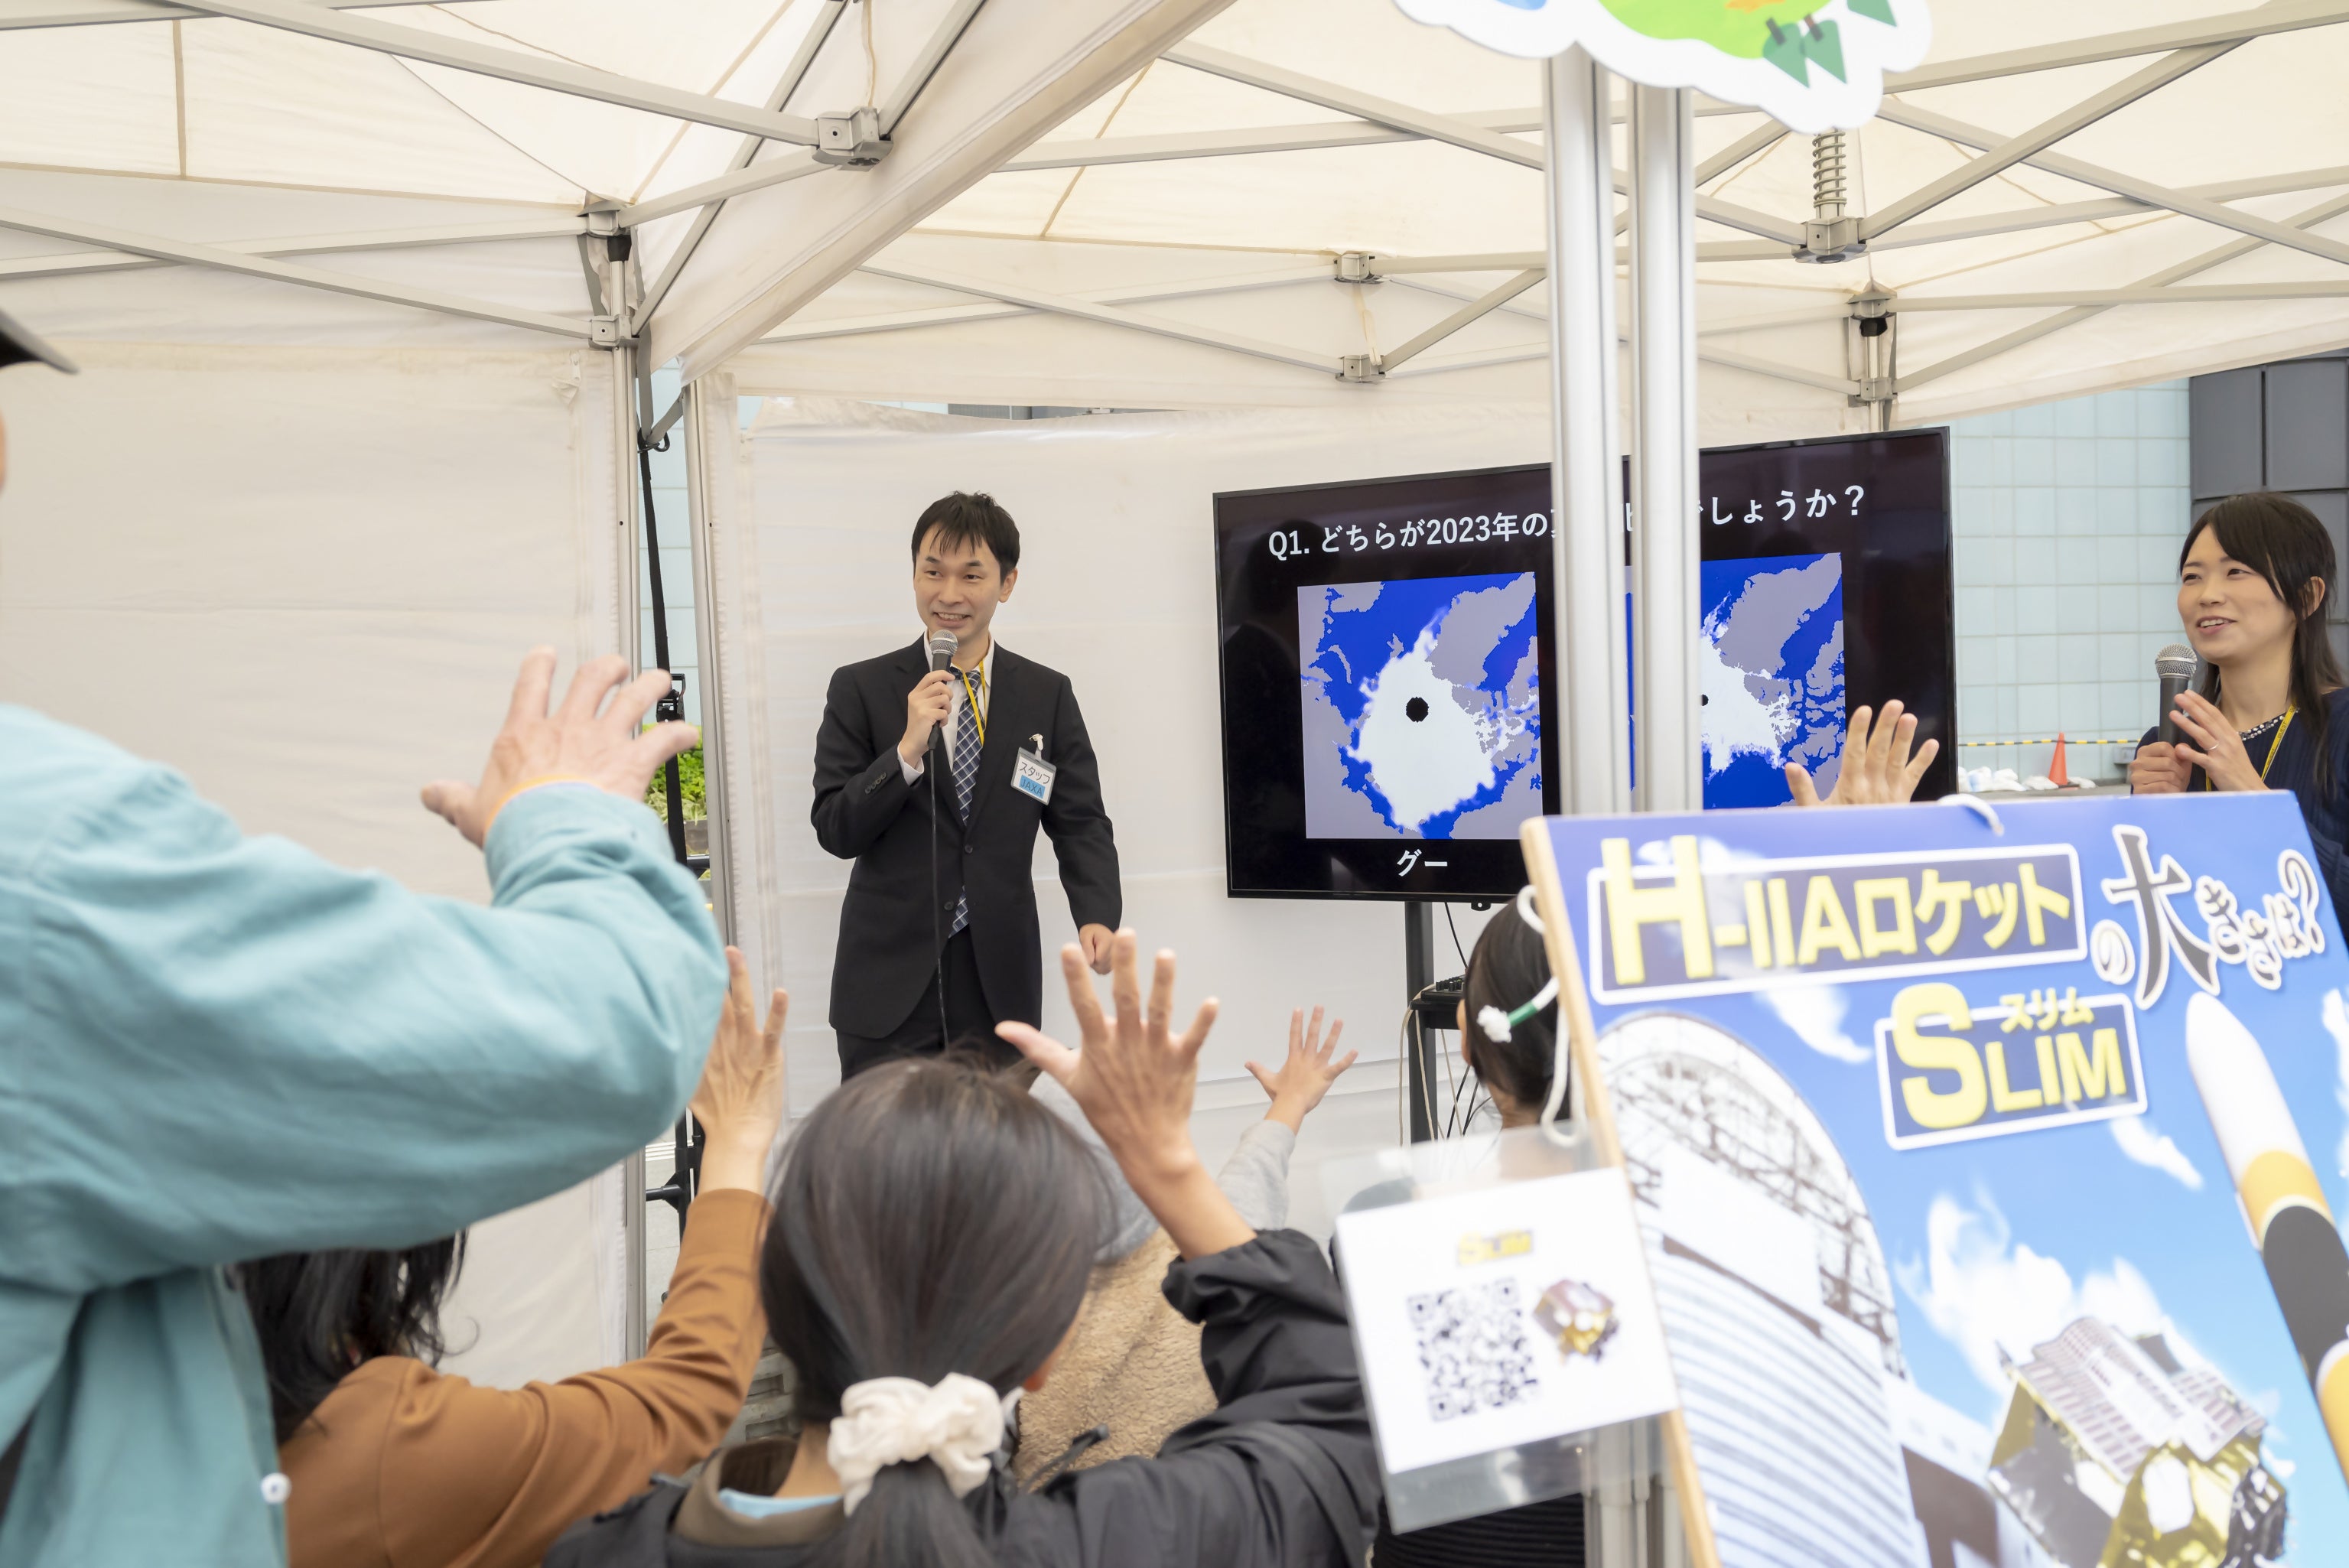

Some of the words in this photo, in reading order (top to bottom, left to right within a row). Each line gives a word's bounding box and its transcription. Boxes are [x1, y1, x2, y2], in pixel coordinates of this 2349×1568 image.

[1268, 529, 1310, 561] Q1.
[1321, 509, 1557, 553] どちらが2023年の
[1019, 761, 1050, 784] スタッフ
[1021, 779, 1043, 796] JAXA
[1396, 848, 1448, 877] グー
[1999, 986, 2095, 1033] スリム
[1891, 982, 2127, 1129] SLIM
